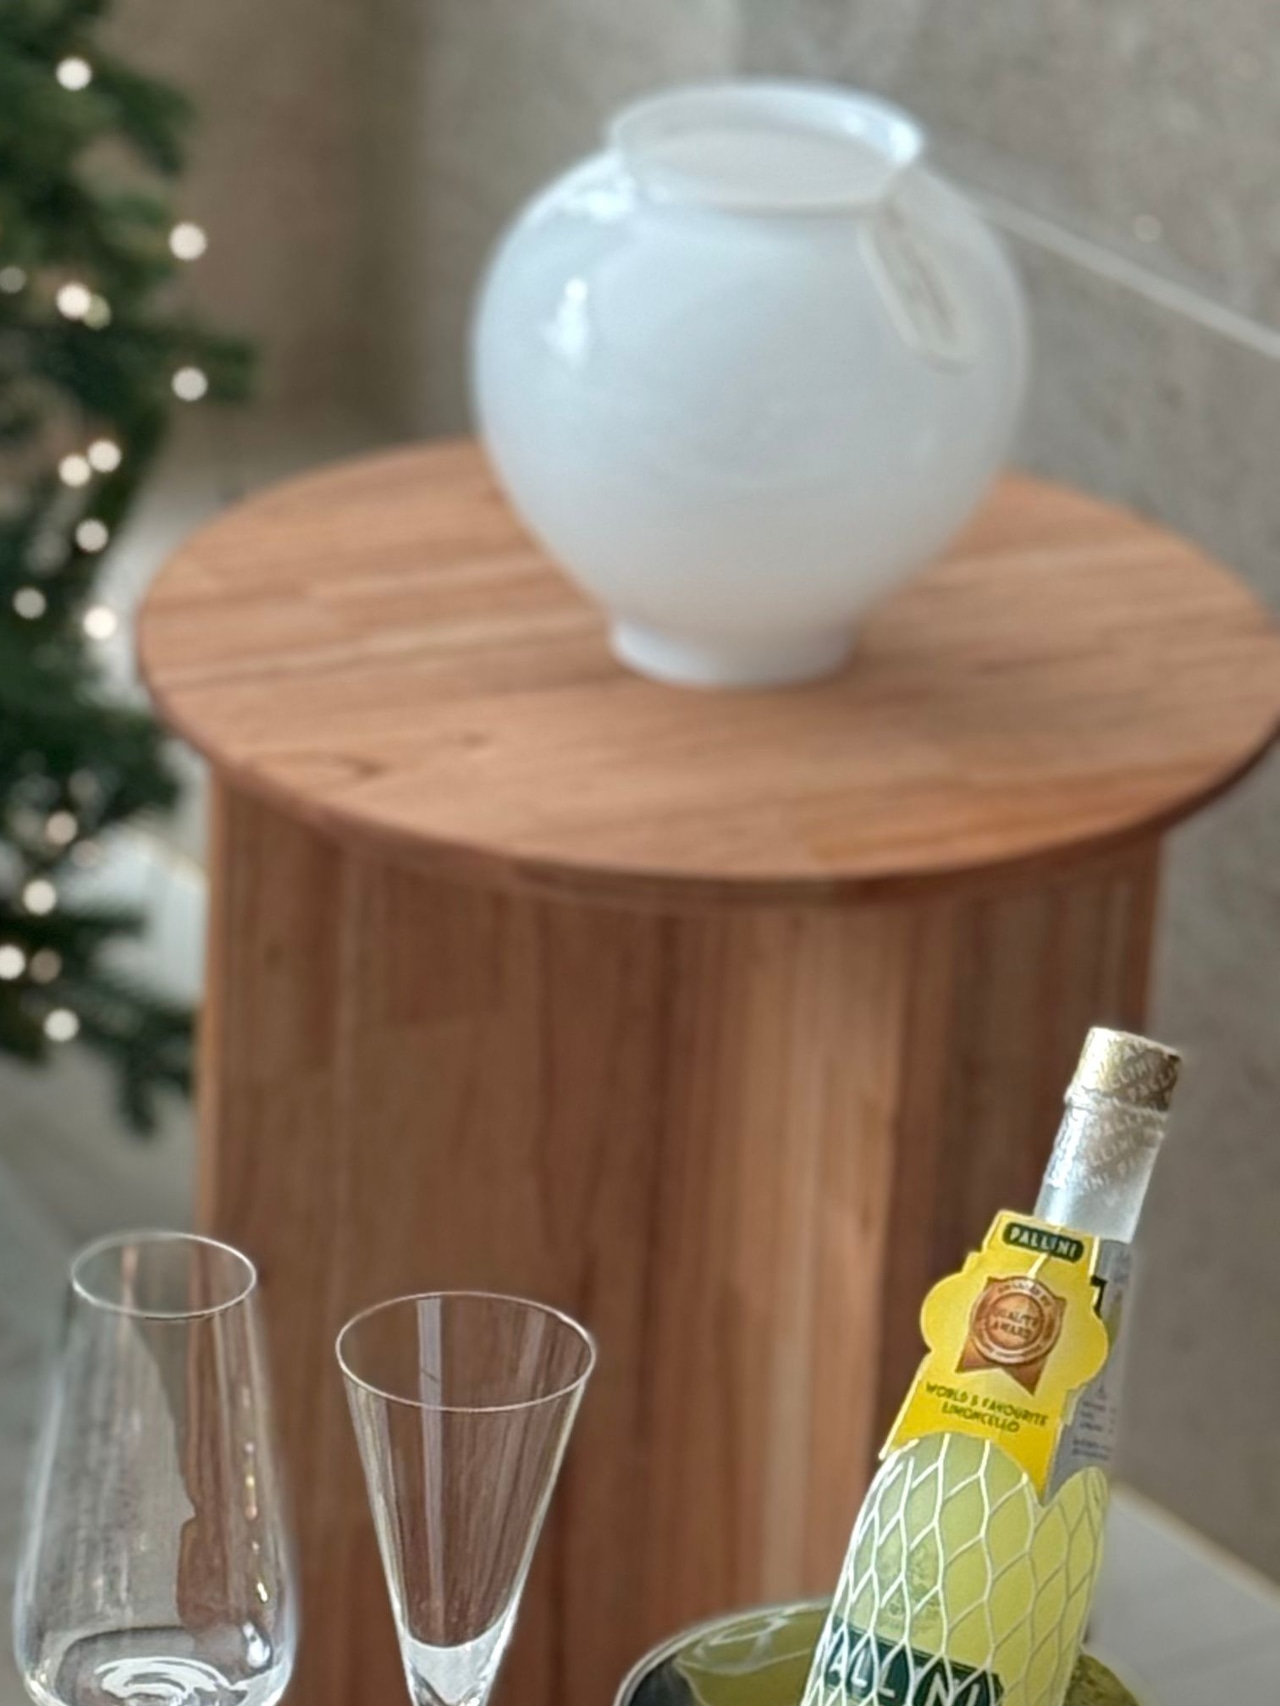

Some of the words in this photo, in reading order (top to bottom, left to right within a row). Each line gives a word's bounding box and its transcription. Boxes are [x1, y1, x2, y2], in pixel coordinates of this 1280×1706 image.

[1009, 1226, 1078, 1258] PALLINI
[926, 1382, 979, 1407] WORLDS
[982, 1396, 1049, 1427] FAVOURITE
[941, 1402, 1021, 1433] LIMONCELLO
